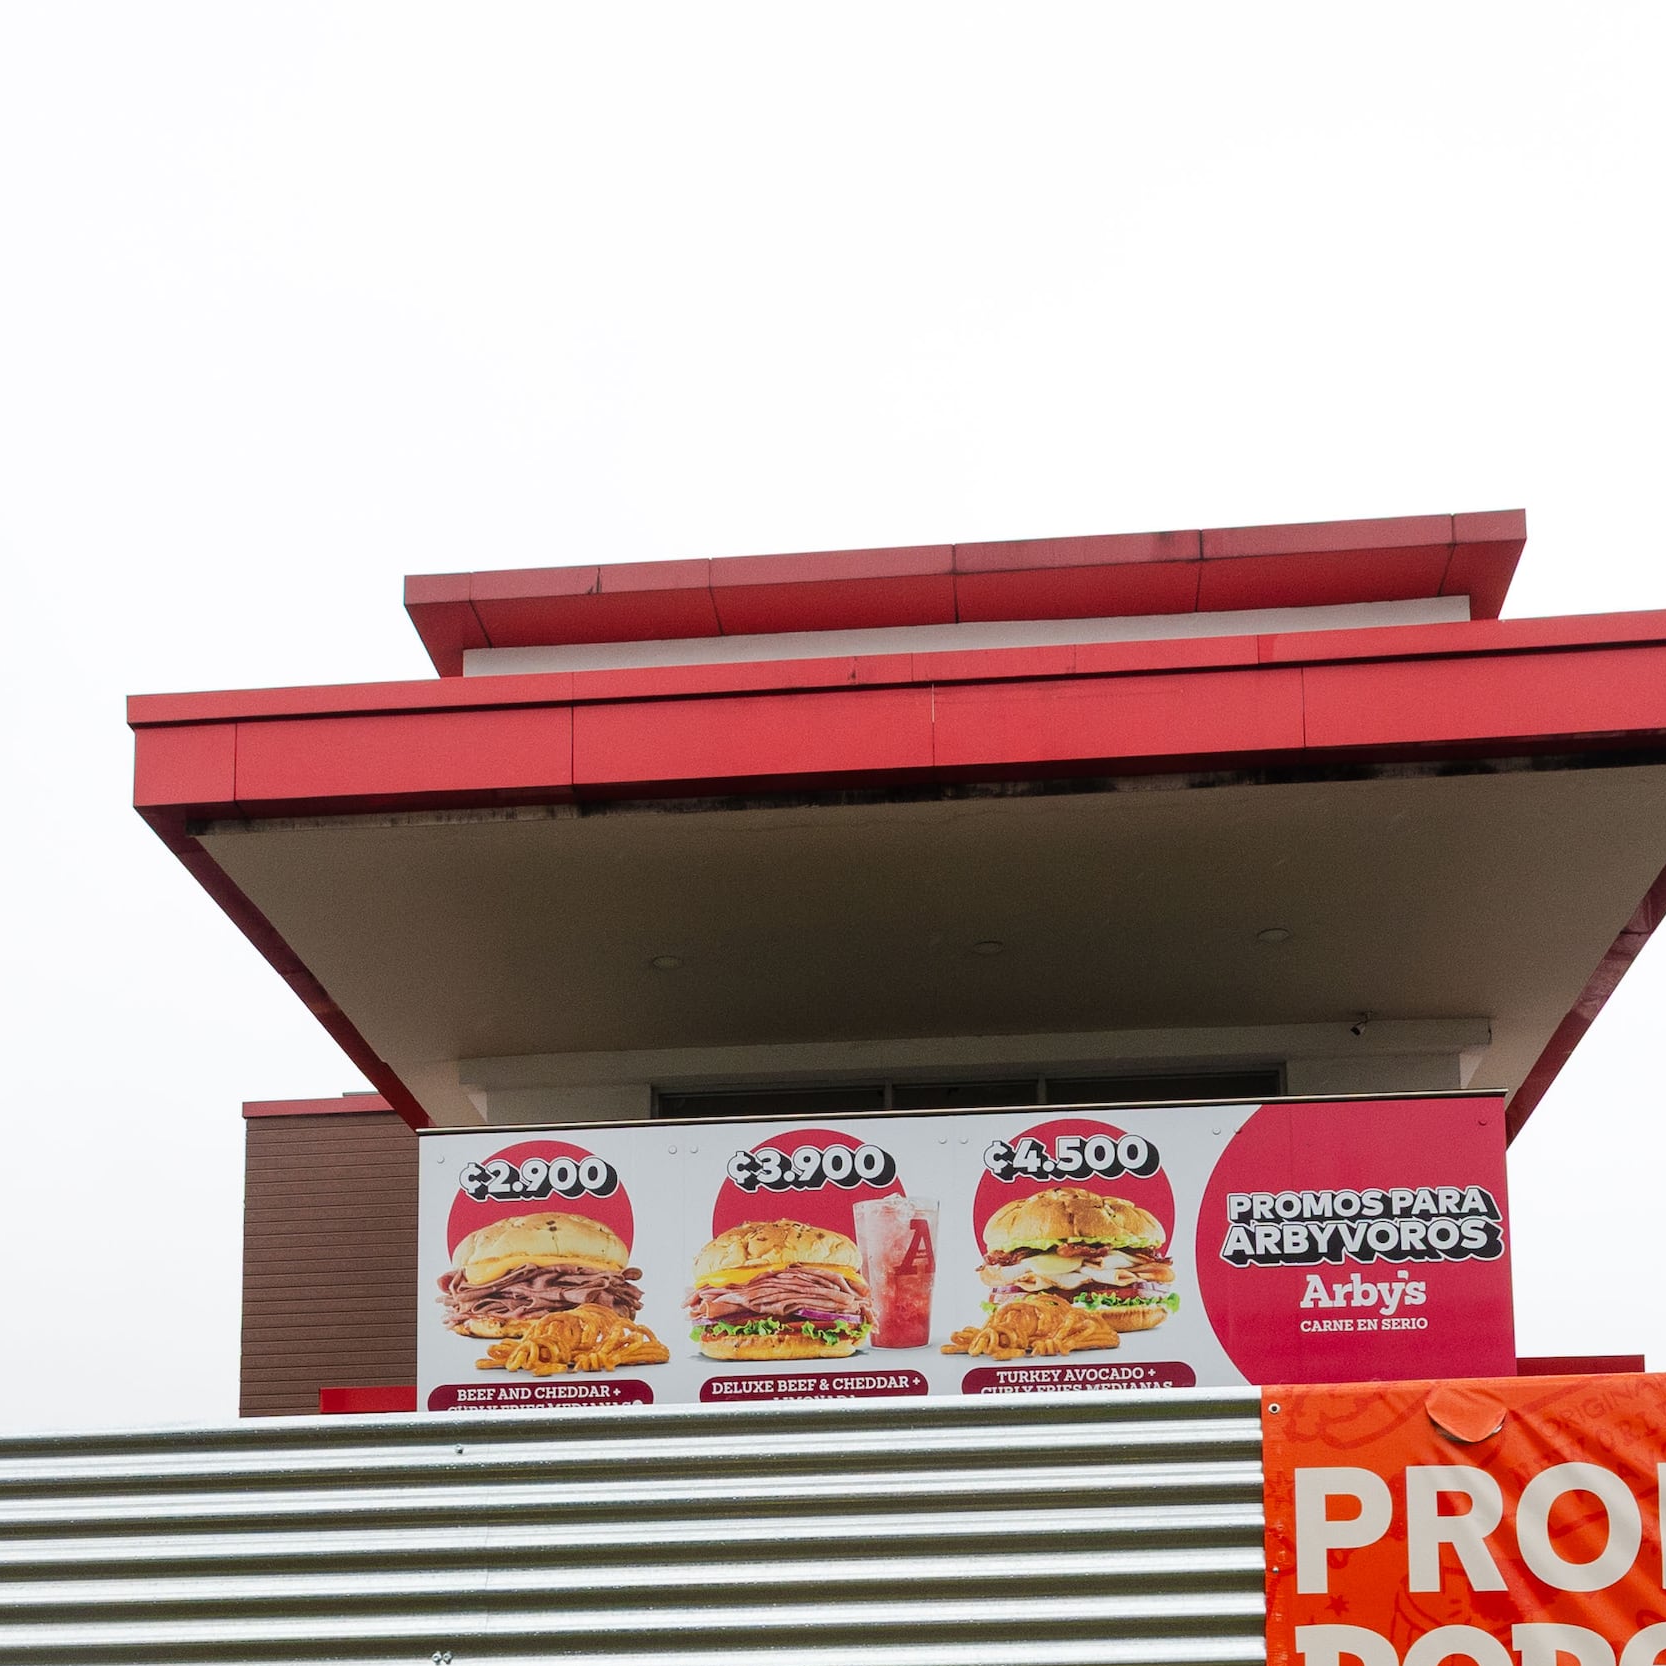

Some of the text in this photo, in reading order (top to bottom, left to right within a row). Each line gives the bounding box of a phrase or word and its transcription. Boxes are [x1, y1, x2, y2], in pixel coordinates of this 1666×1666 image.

[1228, 1187, 1493, 1220] PROMOS PARA
[1222, 1217, 1496, 1260] ARBYVOROS
[1300, 1270, 1427, 1315] Arby's
[1300, 1317, 1428, 1332] CARNE EN SERIO
[711, 1380, 774, 1395] DELUXE
[777, 1378, 817, 1393] BEEF
[832, 1375, 910, 1390] CHEDDAR
[996, 1370, 1062, 1383] TURKEY
[1063, 1367, 1144, 1381] AVOCADO
[456, 1388, 496, 1402] BEEF
[497, 1387, 532, 1400] AND
[534, 1385, 611, 1399] CHEDDAR
